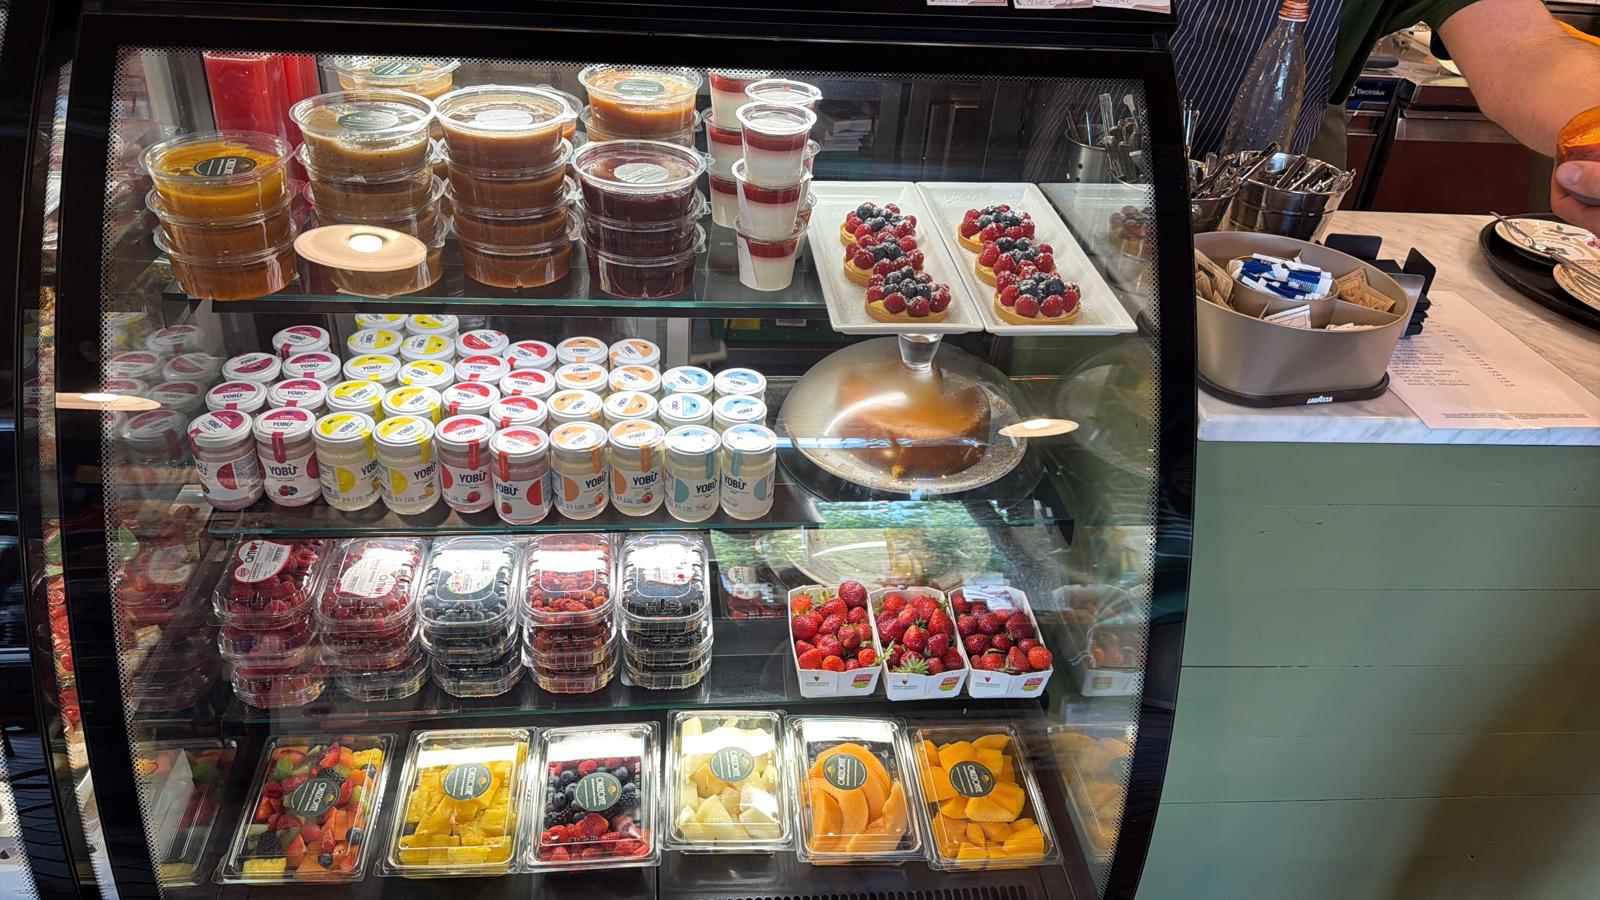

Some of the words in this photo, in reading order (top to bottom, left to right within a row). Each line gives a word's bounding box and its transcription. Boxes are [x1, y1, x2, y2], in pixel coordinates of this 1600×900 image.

[1356, 88, 1386, 97] Electrolux
[269, 463, 298, 476] YOBÙ
[361, 458, 378, 476] YOB
[414, 461, 437, 481] YOBÙ
[459, 470, 488, 484] YOBÙ
[585, 471, 607, 489] YOBÙ
[632, 471, 658, 486] YOBÙ
[724, 474, 747, 490] YOBÙ
[494, 483, 519, 496] YOBÙ
[696, 477, 718, 494] YOBÙ
